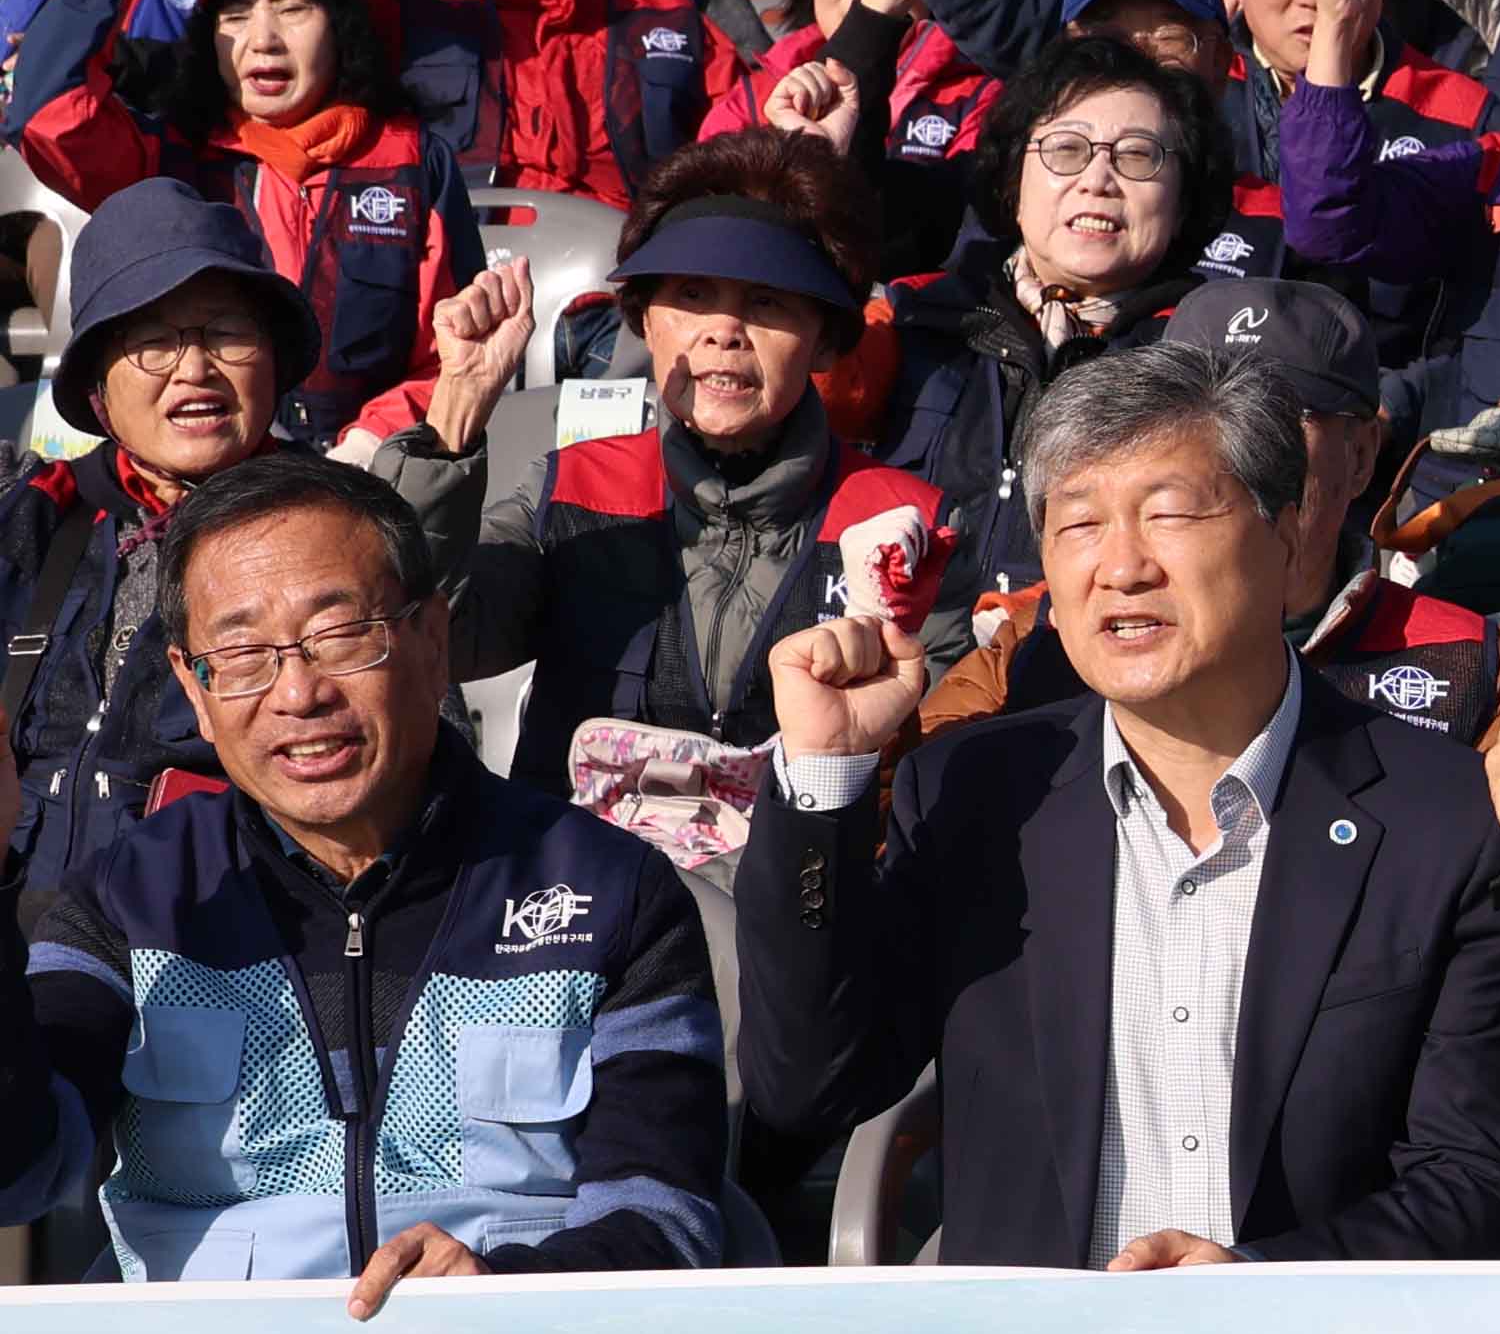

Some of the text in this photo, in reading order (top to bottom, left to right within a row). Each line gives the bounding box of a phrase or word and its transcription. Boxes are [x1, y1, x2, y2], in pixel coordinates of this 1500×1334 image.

[642, 32, 689, 52] KFF
[906, 120, 957, 146] KFF
[350, 194, 406, 221] KFF
[1368, 672, 1451, 709] KFF
[503, 894, 593, 940] KFF
